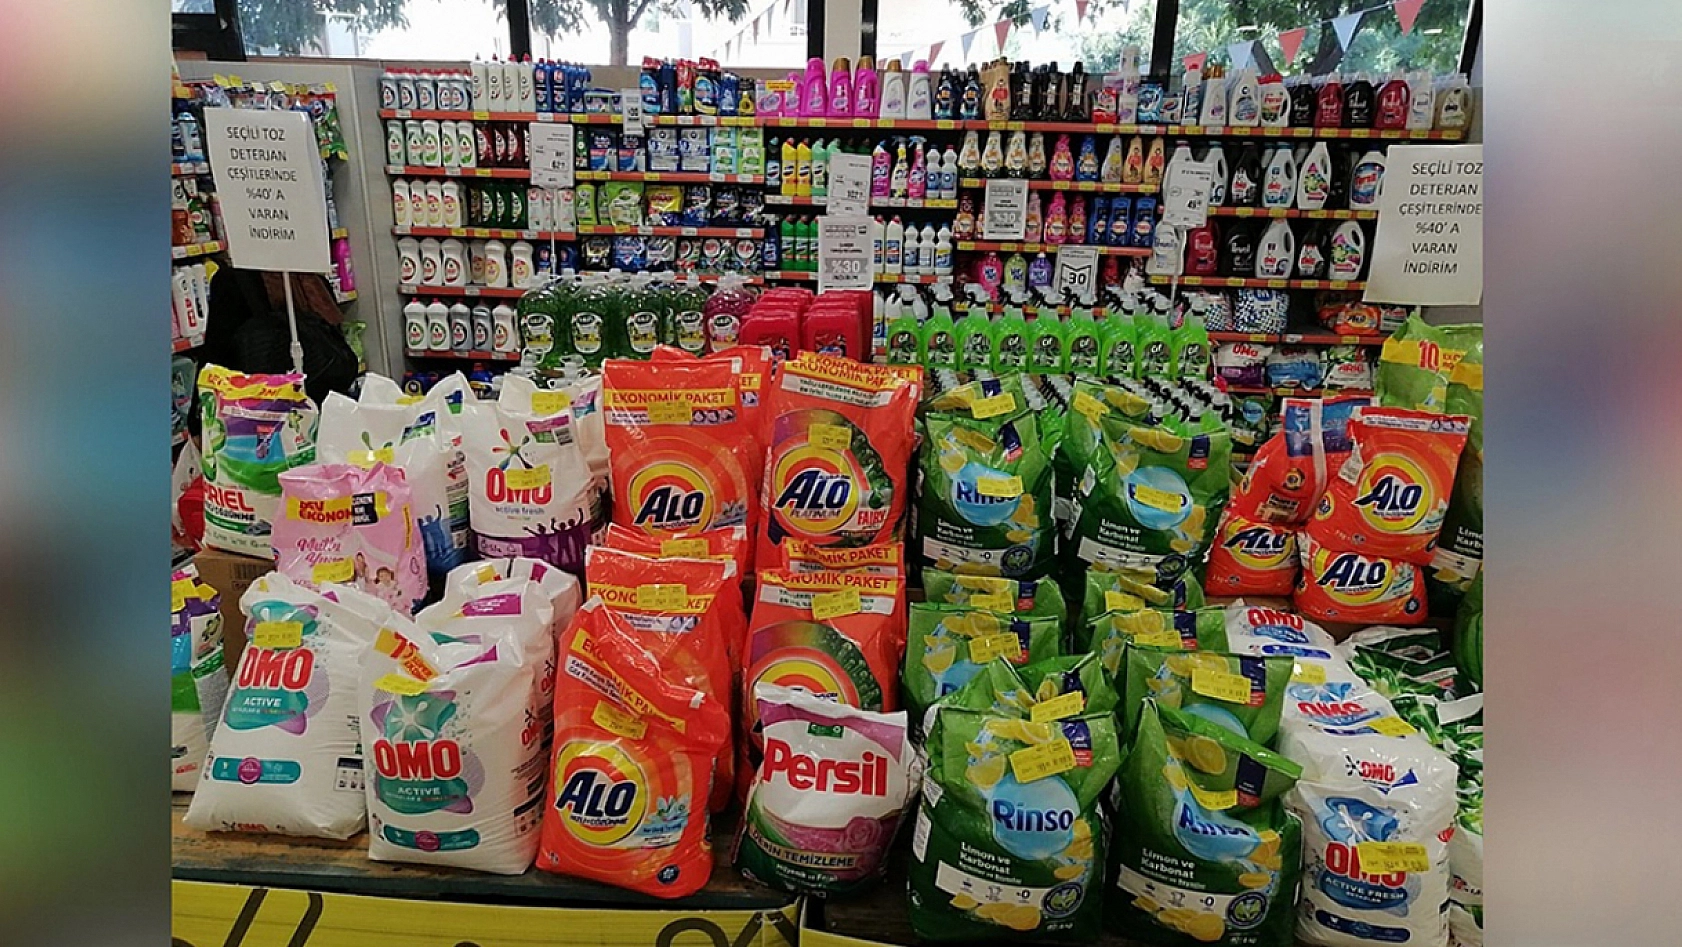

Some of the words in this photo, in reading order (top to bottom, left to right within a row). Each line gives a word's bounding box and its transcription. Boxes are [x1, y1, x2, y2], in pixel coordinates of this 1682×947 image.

[227, 125, 259, 142] SEÇİLİ
[263, 128, 286, 141] TOZ
[230, 147, 287, 161] DETERJAN
[227, 166, 298, 182] ÇEŞİTLERİNDE
[1411, 159, 1452, 177] SEÇİLİ
[1457, 163, 1483, 175] TOZ
[276, 189, 285, 201] A
[1409, 183, 1479, 196] DETERJAN
[249, 207, 290, 221] VARAN
[1399, 202, 1483, 217] ÇEŞİTLERİNDE
[249, 225, 296, 240] İNDİRİM
[1450, 223, 1460, 234] A
[1412, 242, 1458, 254] VARAN
[832, 260, 860, 273] %30
[1403, 260, 1458, 274] İNDİRİM
[685, 391, 726, 404] PAKET
[774, 469, 852, 510] ALO
[1353, 477, 1423, 509] ALO
[633, 485, 706, 526] ALO
[857, 511, 887, 525] FAIRY
[1223, 528, 1287, 549] ALO
[850, 547, 891, 562] PAKET
[1317, 554, 1387, 586] ALO
[843, 576, 891, 589] PAKET
[1246, 608, 1304, 631] OMO
[238, 646, 315, 690] OMO
[243, 696, 282, 708] ACTIVE
[374, 739, 462, 780] OMO
[763, 736, 888, 797] Persil
[1361, 760, 1396, 783] OMO
[397, 786, 441, 796] ACTIVE
[554, 771, 637, 817] ALO
[992, 798, 1075, 833] Rinso
[961, 841, 996, 861] Limon
[997, 856, 1011, 865] ve
[1142, 847, 1179, 866] Limon
[1181, 860, 1195, 869] ve
[960, 851, 1011, 875] Karbonat
[1141, 857, 1194, 879] Karbonat
[1325, 877, 1364, 894] ACTIVE
[1368, 891, 1404, 900] FRESH
